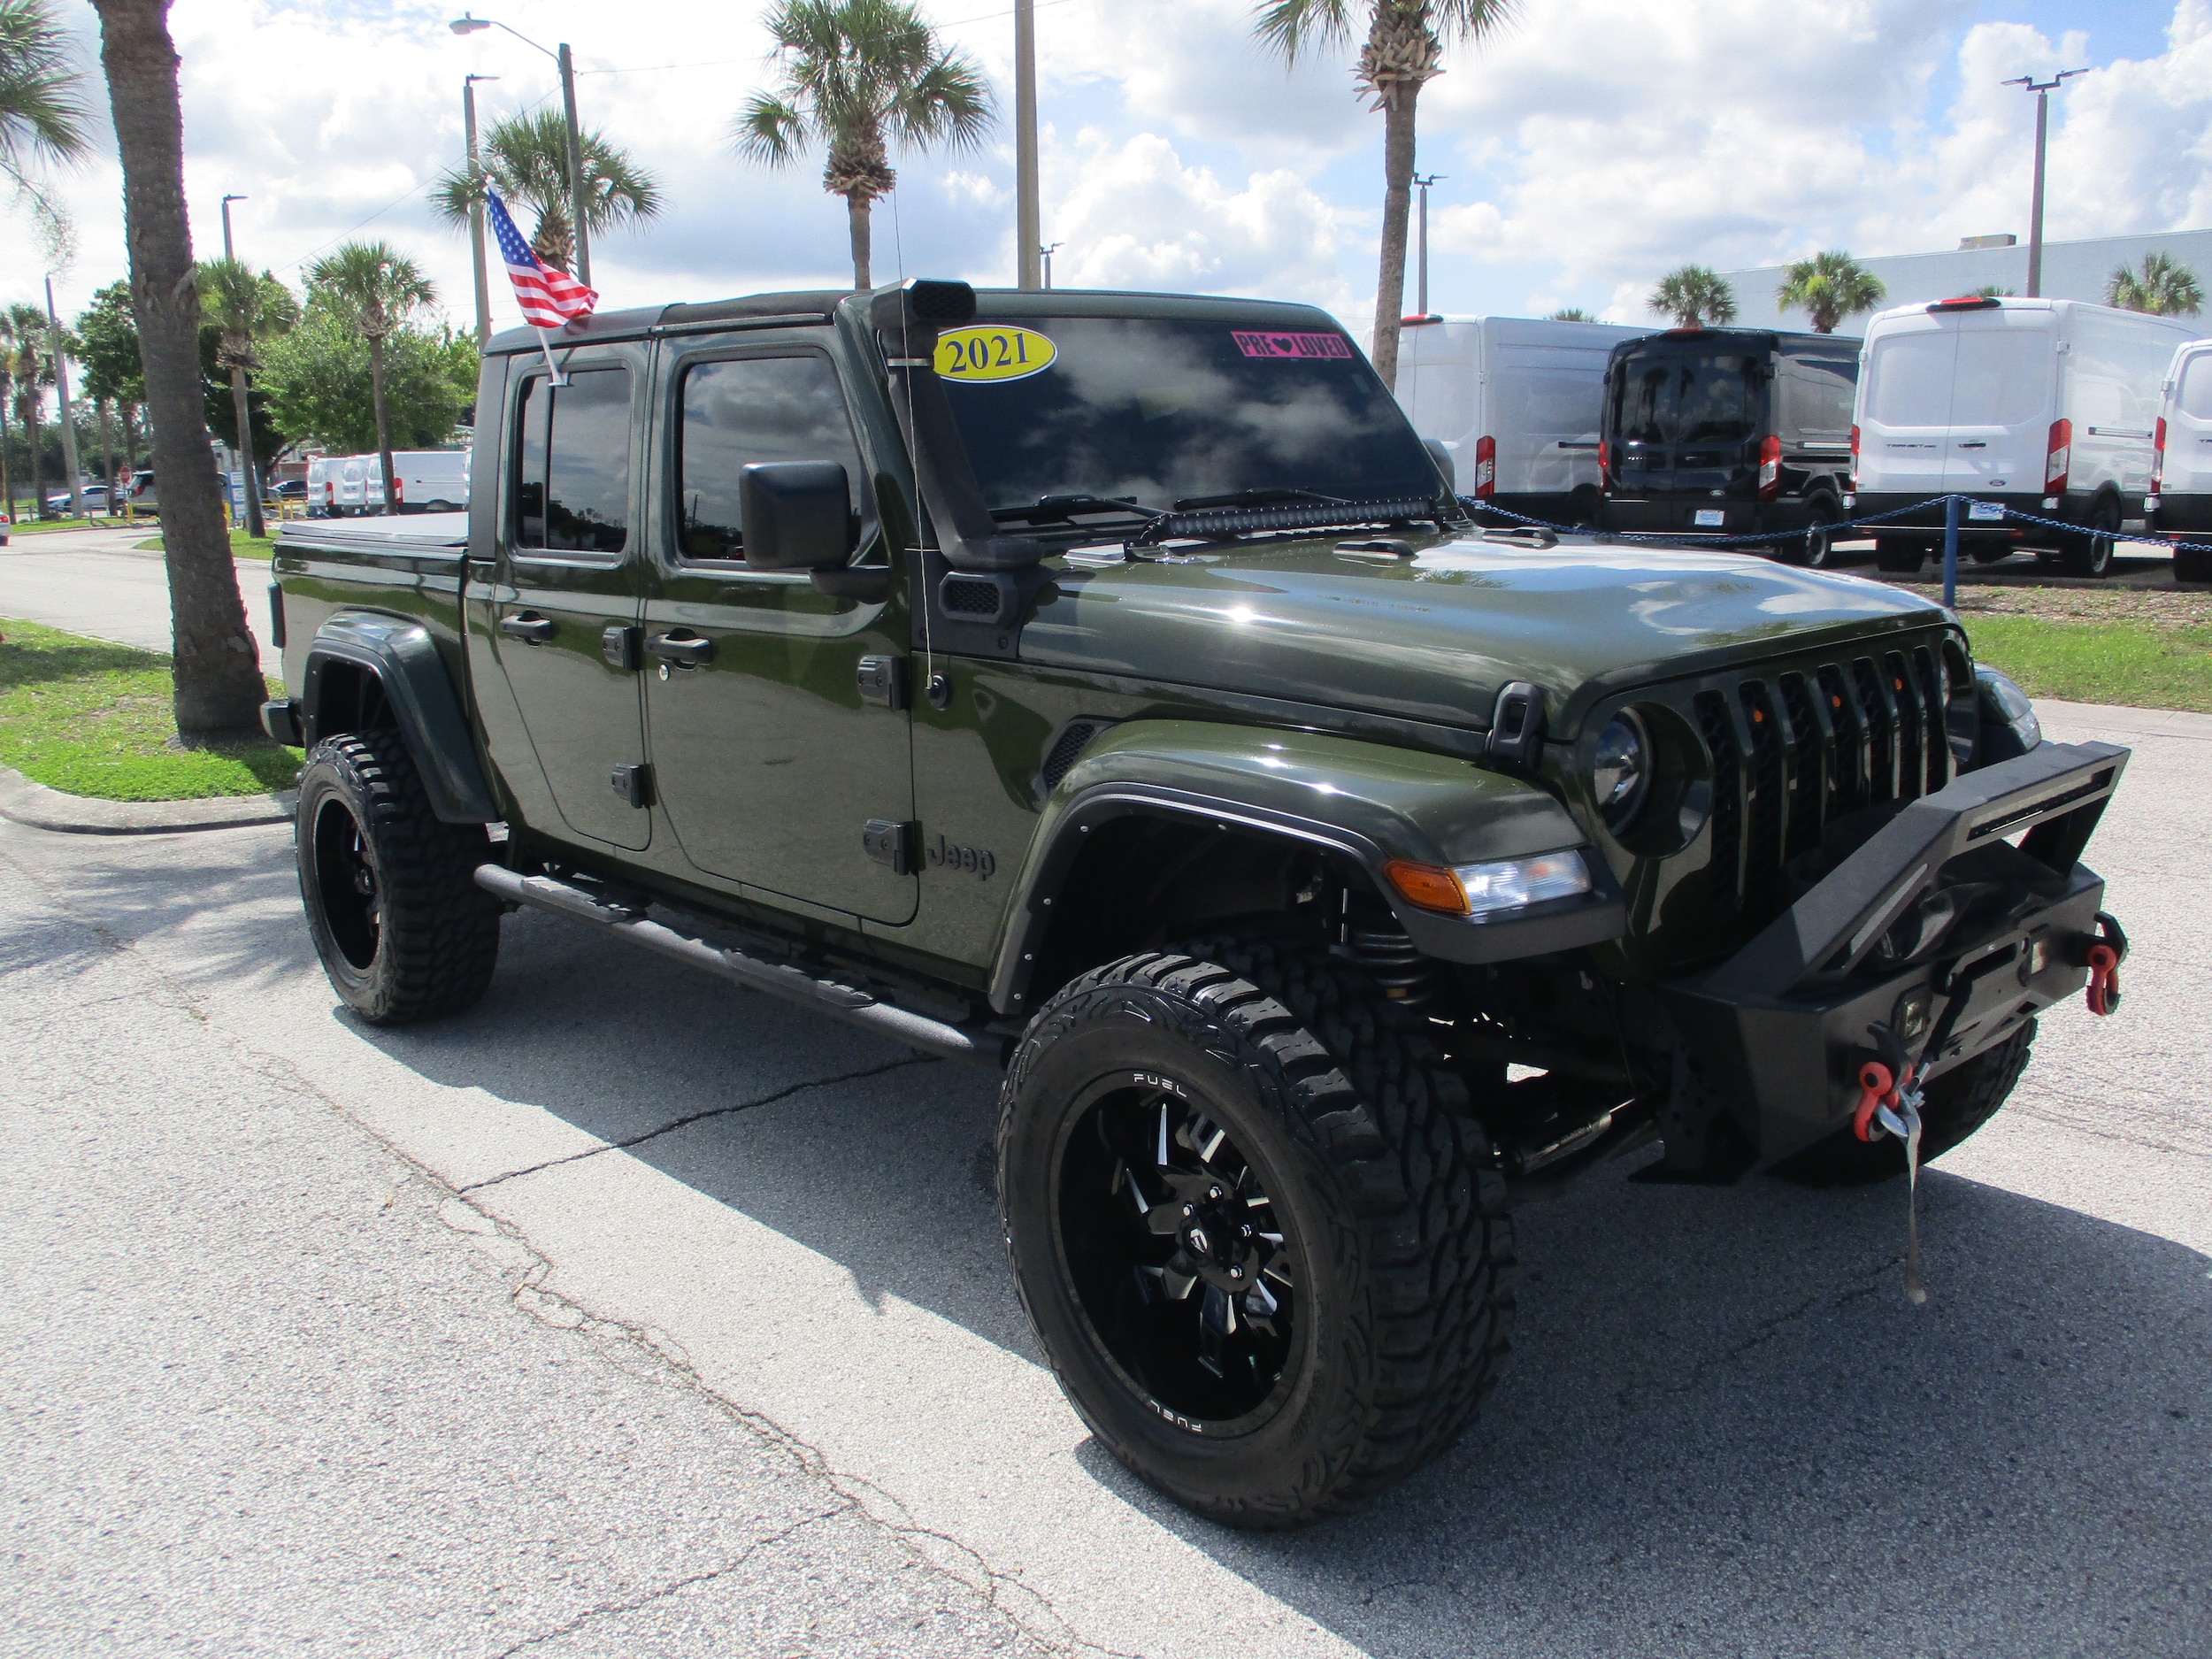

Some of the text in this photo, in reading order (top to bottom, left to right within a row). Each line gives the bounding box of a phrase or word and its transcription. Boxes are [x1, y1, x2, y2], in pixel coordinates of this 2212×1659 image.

[945, 332, 1031, 373] 2021
[1235, 334, 1348, 356] PRE LOVED
[926, 834, 995, 881] Jeep
[1133, 1073, 1187, 1098] FUEL
[1149, 1400, 1202, 1432] FUEL
